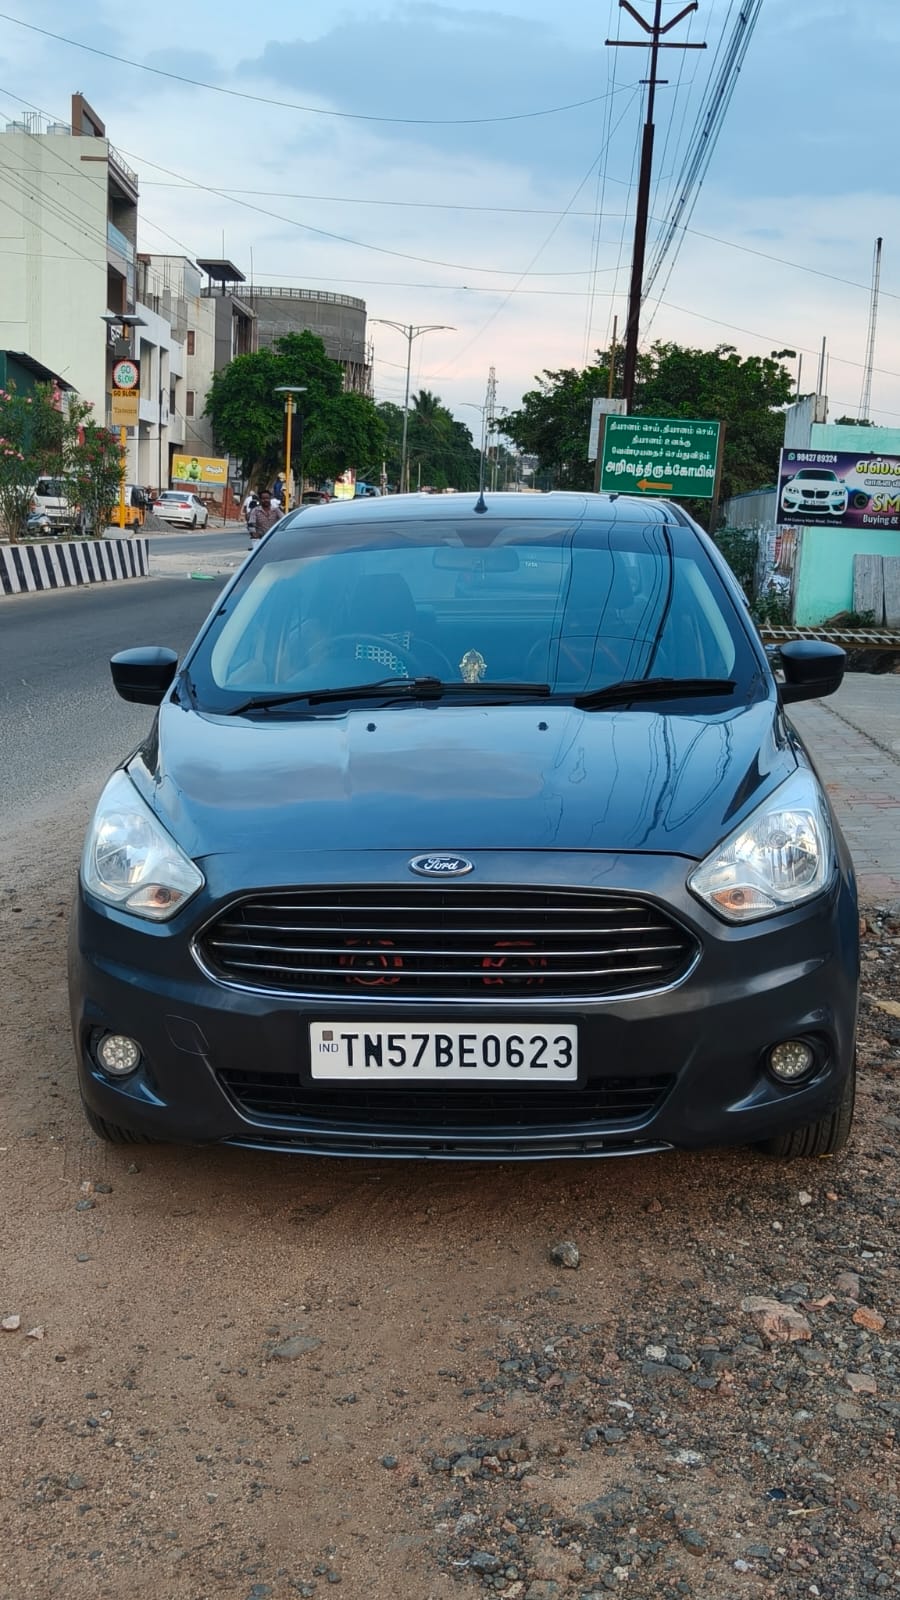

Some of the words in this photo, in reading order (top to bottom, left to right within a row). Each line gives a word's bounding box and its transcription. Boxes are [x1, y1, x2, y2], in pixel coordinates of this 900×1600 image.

[863, 514, 890, 525] Buying
[424, 857, 459, 870] Ford
[319, 1043, 338, 1053] IND
[341, 1034, 573, 1068] TN57BE0623
